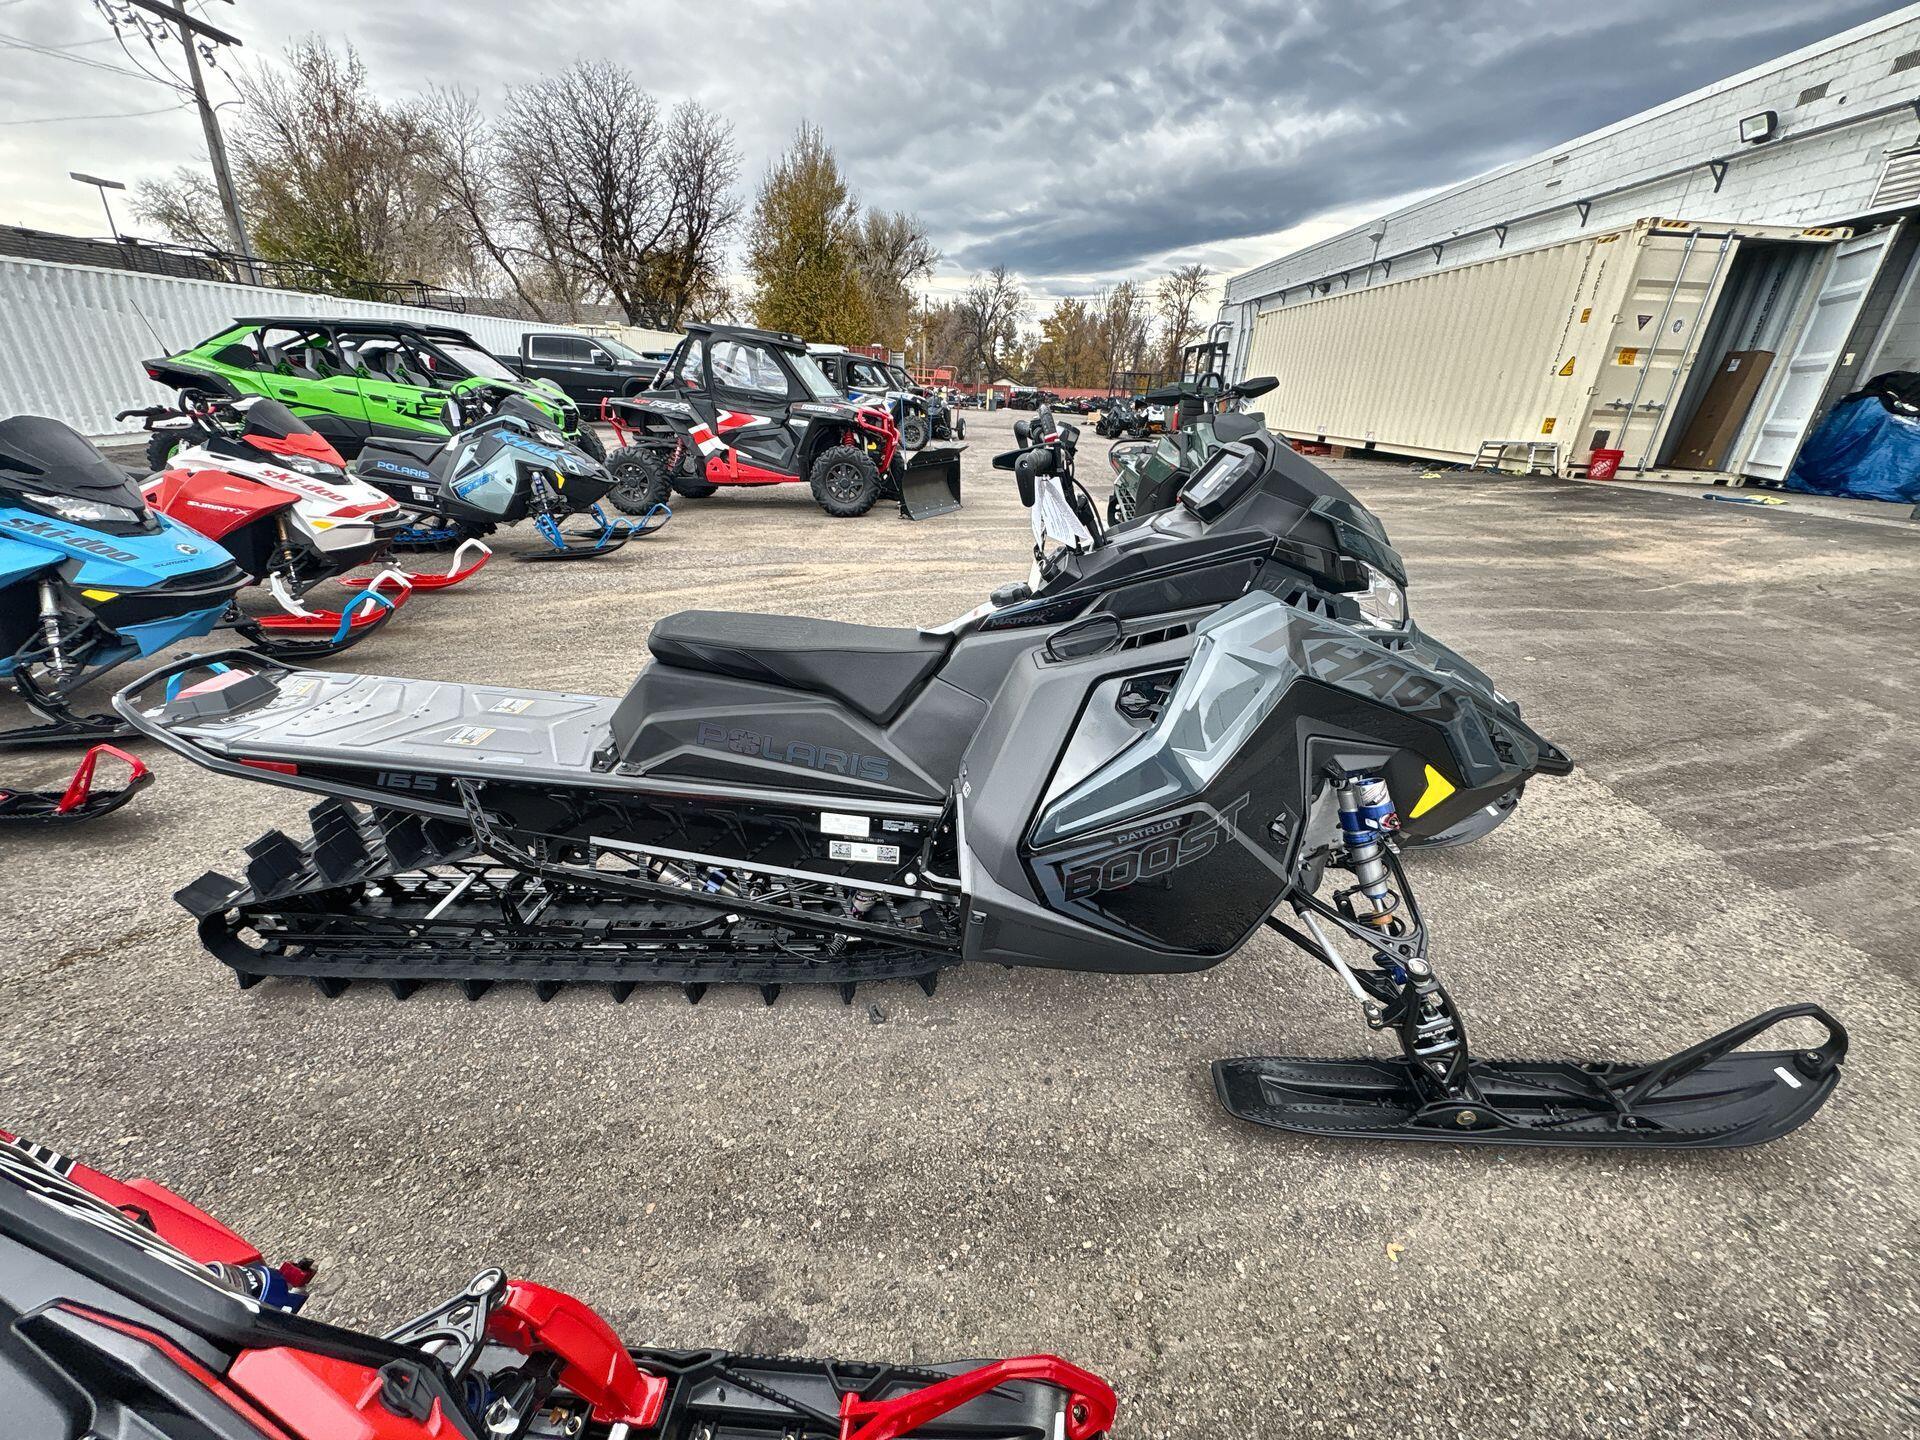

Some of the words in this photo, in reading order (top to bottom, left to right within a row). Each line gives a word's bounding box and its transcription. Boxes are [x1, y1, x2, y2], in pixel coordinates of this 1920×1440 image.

[377, 460, 430, 480] POLARIS
[260, 469, 349, 502] ski-doo
[187, 500, 236, 513] SUMMIT
[3, 517, 140, 562] ski-doo
[696, 720, 891, 783] POLARIS
[377, 771, 439, 791] 165
[1117, 817, 1183, 844] PATRIOT
[1063, 791, 1251, 902] BOOST
[1417, 1024, 1454, 1040] POLARIS
